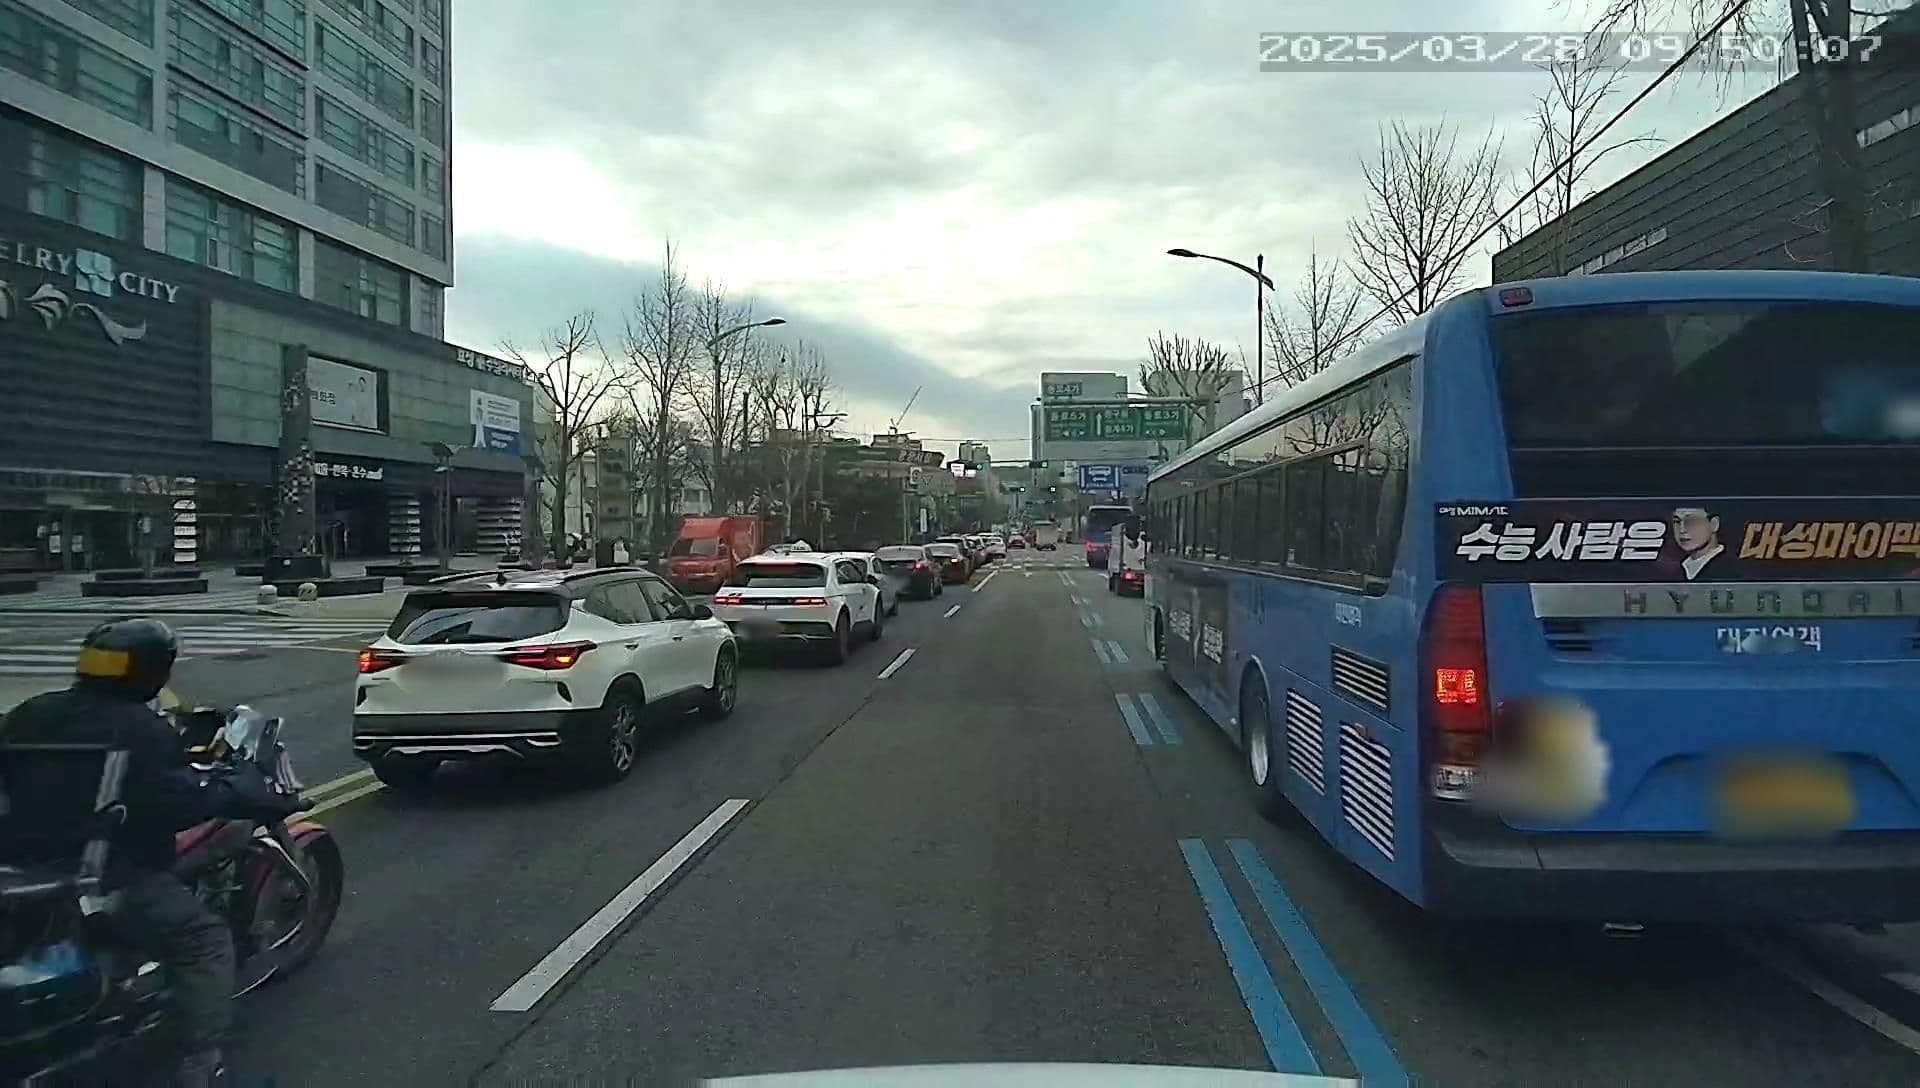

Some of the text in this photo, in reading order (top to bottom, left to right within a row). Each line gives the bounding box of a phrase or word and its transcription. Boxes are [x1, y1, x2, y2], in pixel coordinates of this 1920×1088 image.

[119, 271, 180, 304] CITY
[1456, 522, 1537, 561] 수능
[1534, 521, 1667, 561] 사람은
[1623, 588, 1904, 614] HYUNDAI
